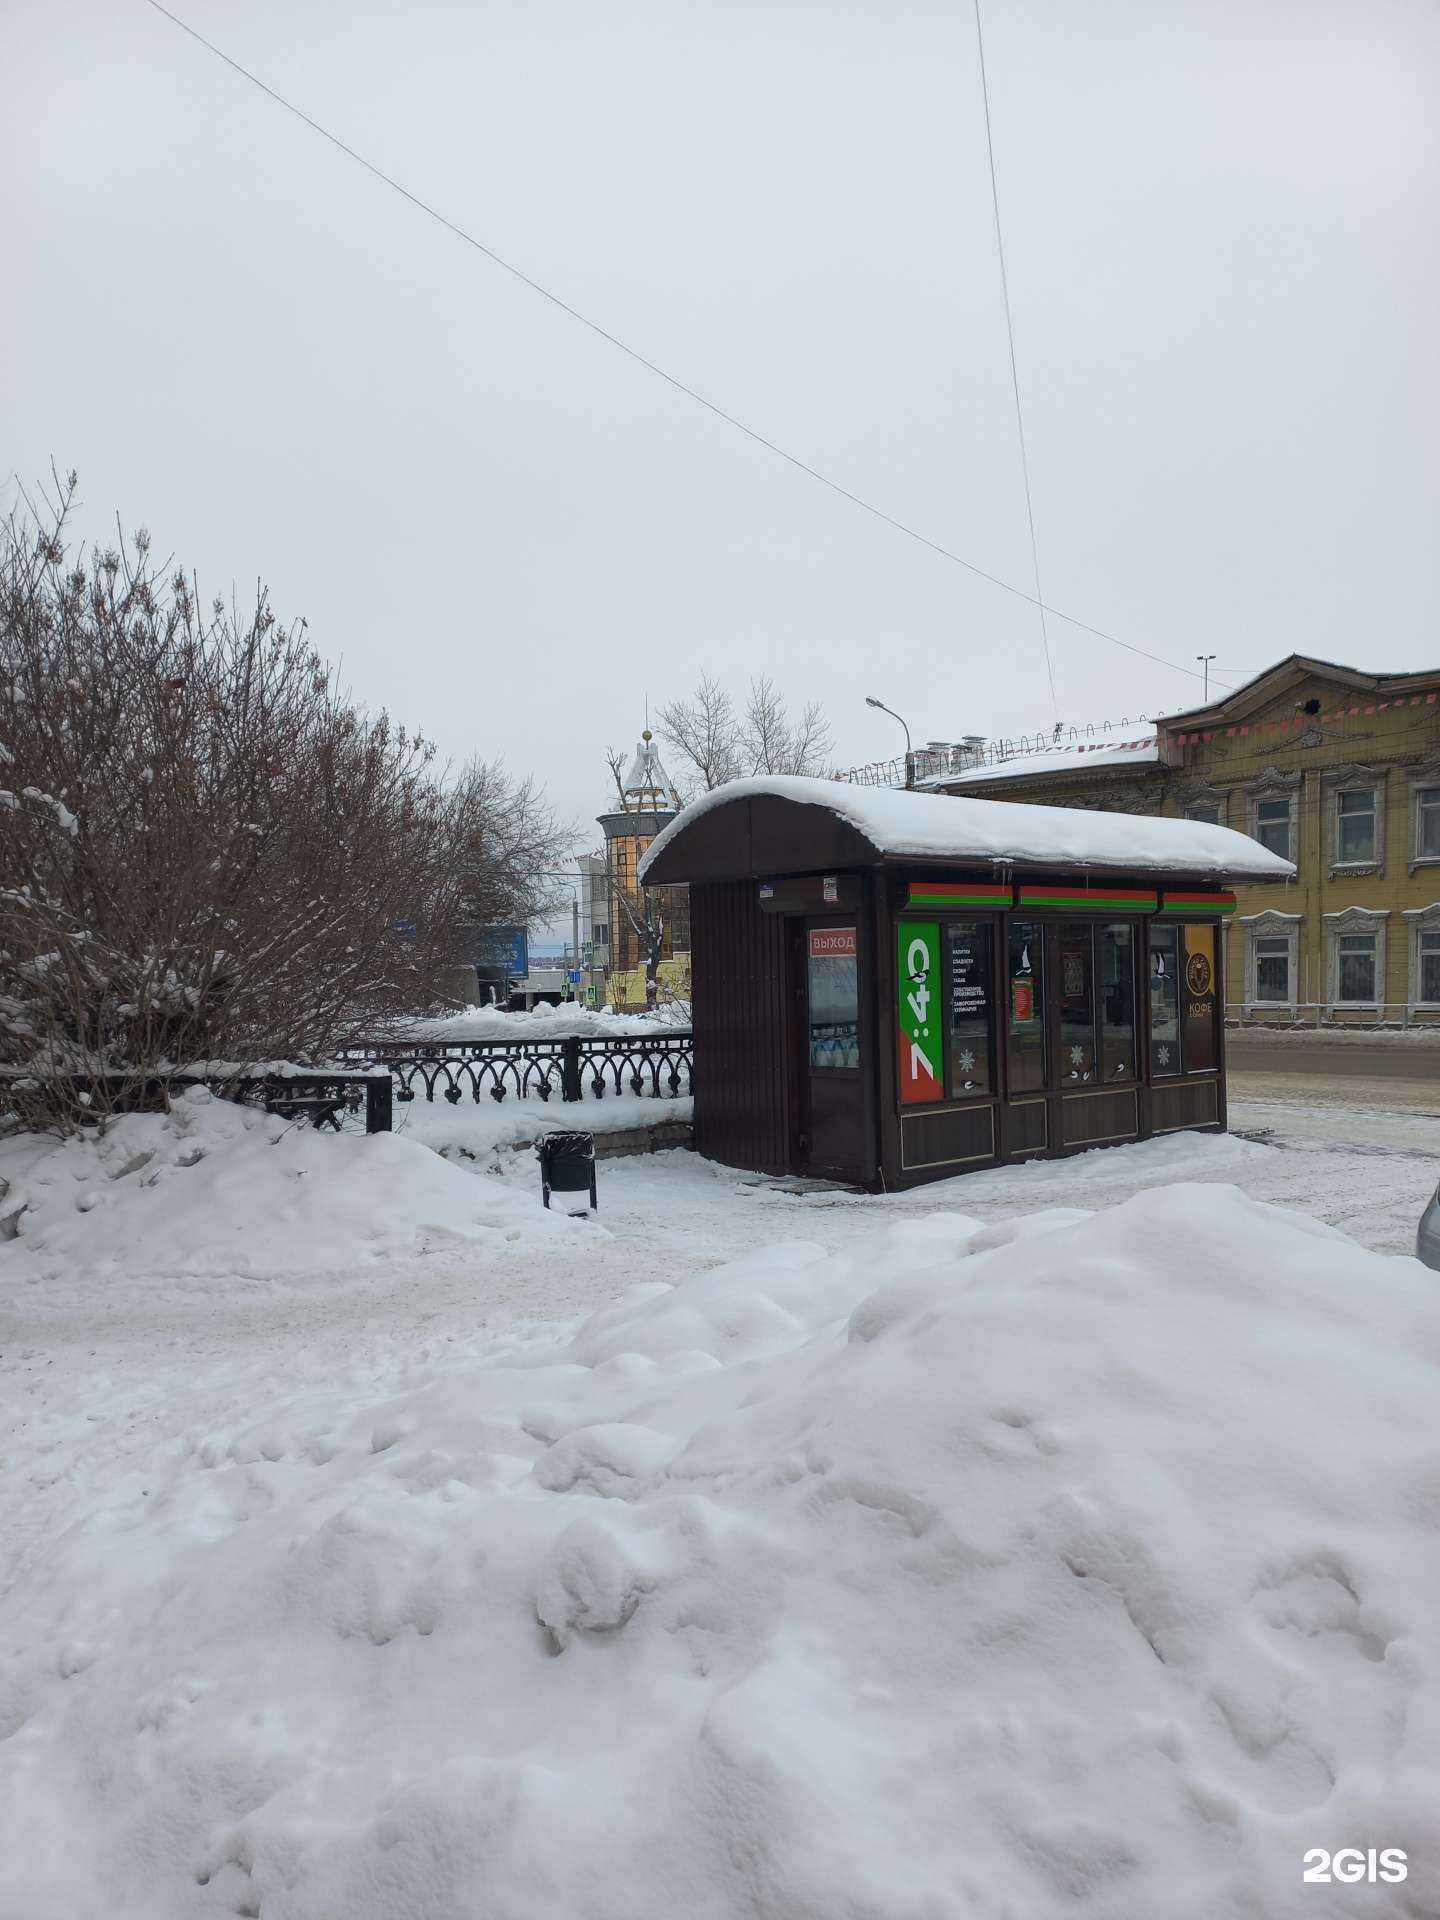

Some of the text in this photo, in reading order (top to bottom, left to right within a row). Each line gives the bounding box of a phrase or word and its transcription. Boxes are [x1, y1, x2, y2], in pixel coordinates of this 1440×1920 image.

[813, 936, 855, 950] ВЫХОД
[906, 938, 934, 1081] 7:40
[1189, 1002, 1213, 1013] КОФЕ
